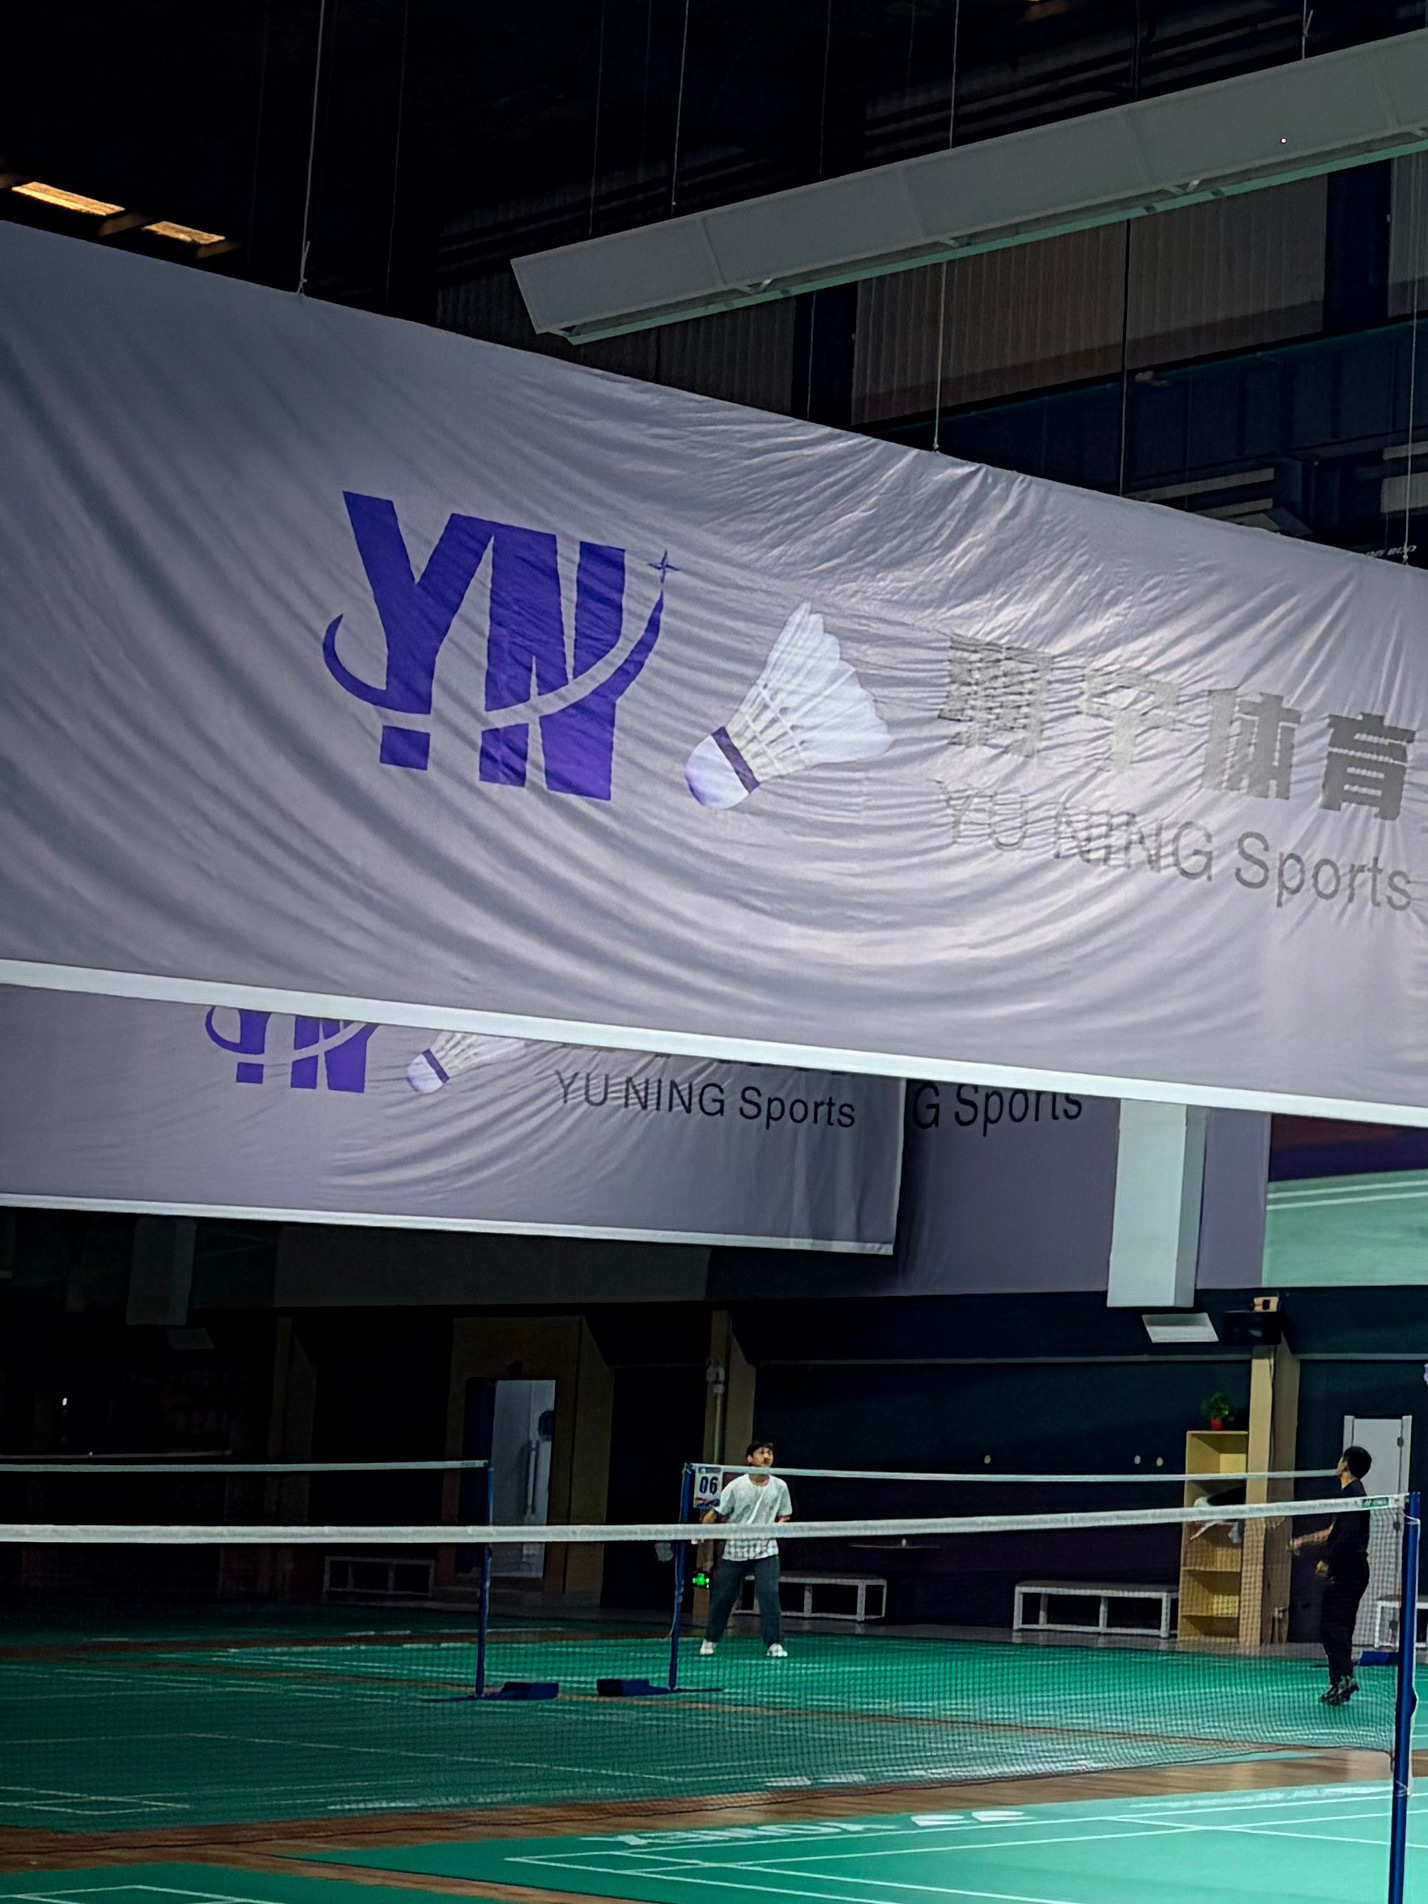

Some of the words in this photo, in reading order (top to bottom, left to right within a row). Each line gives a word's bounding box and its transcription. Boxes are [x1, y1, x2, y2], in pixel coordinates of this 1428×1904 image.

[1234, 831, 1414, 911] Sports
[555, 1069, 610, 1107] YU
[624, 1076, 727, 1118] NING
[738, 1086, 856, 1130] Sports
[699, 1476, 719, 1495] 06
